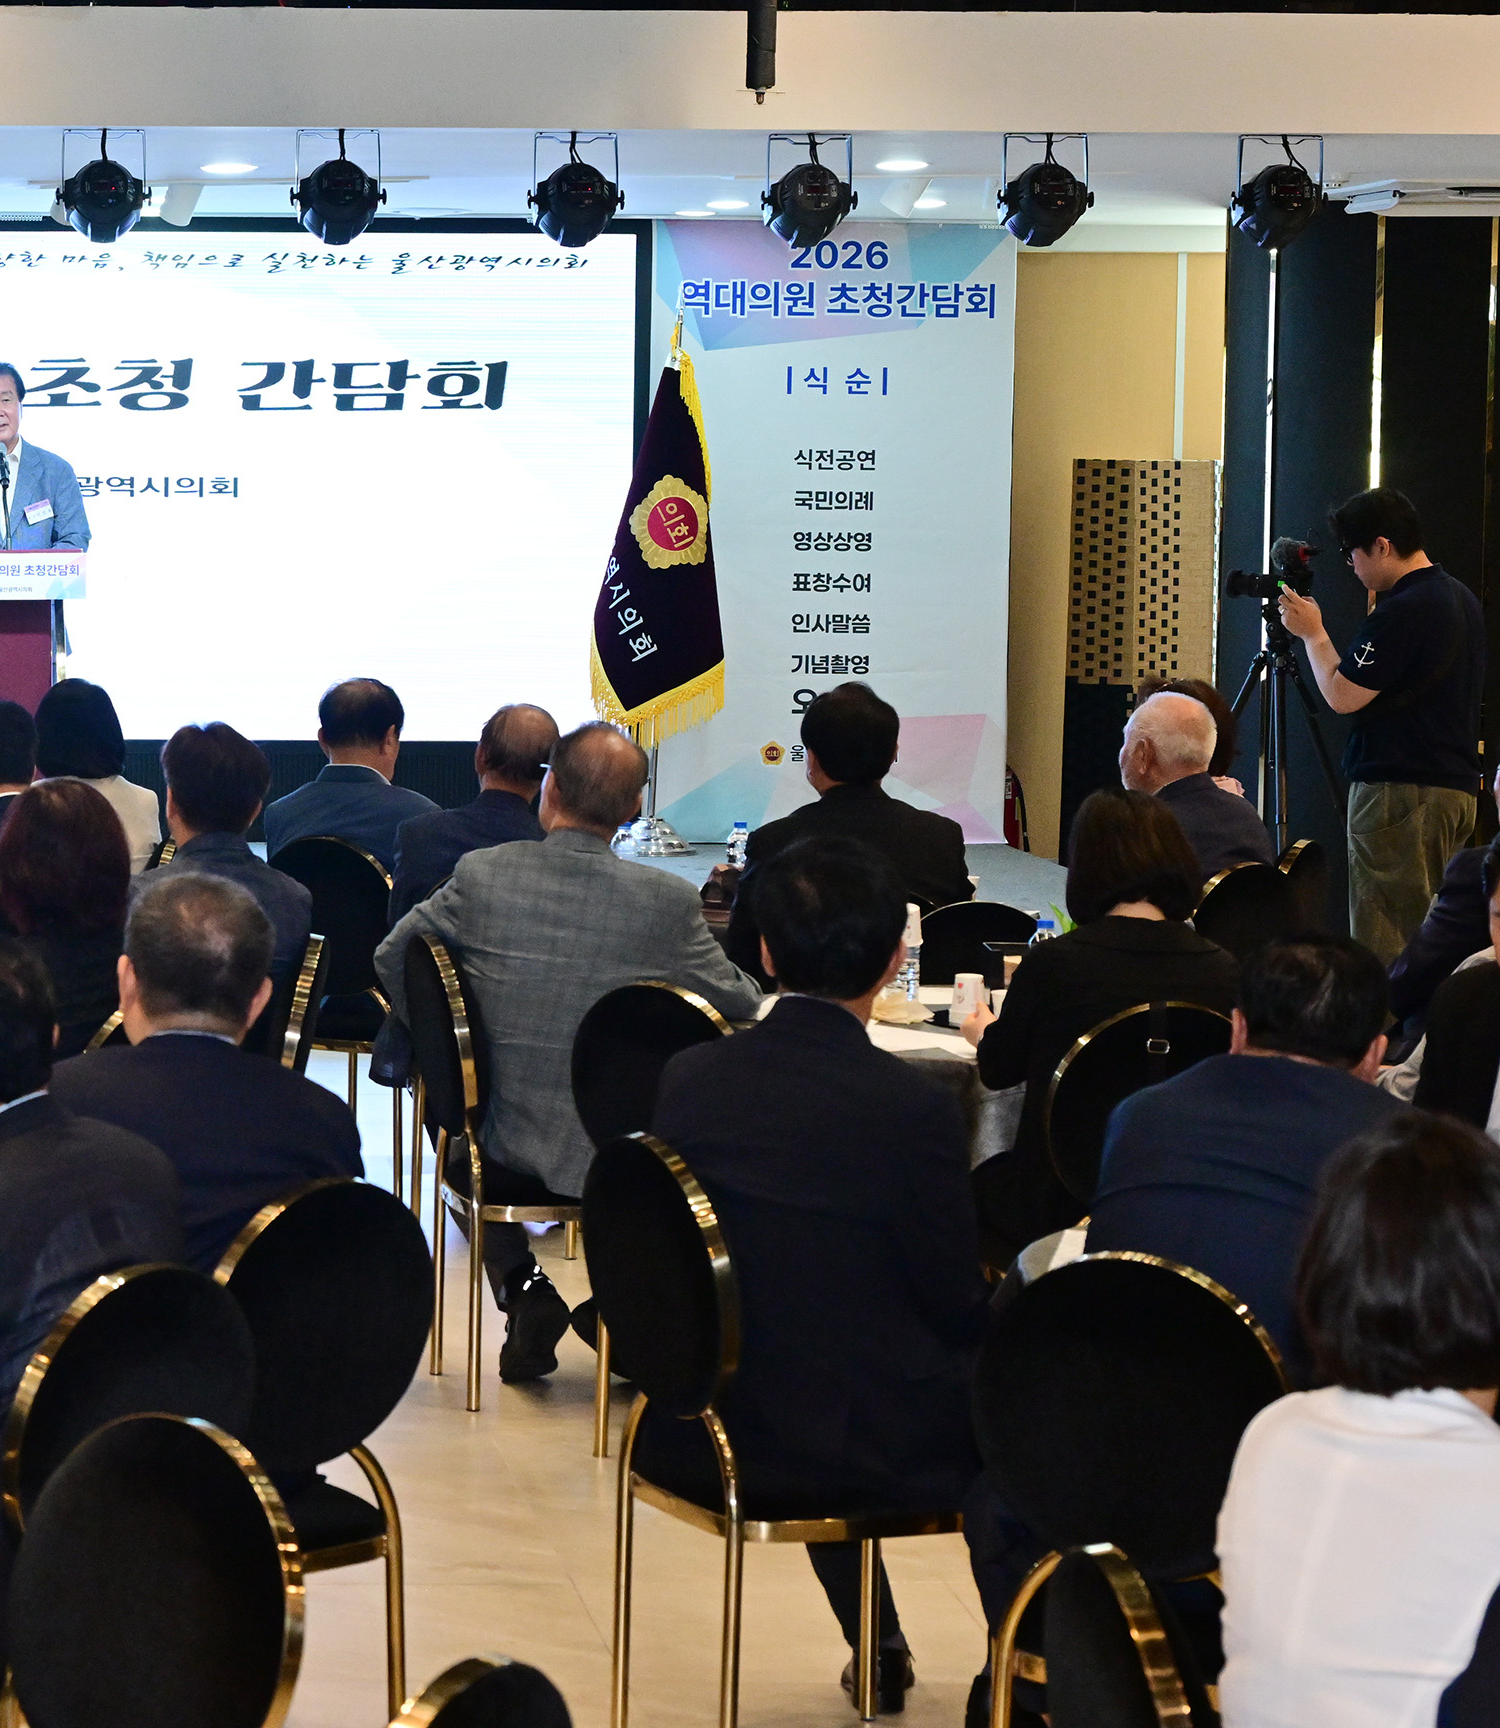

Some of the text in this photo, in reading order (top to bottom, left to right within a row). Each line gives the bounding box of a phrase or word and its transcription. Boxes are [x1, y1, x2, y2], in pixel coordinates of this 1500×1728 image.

[62, 252, 124, 272] 마음,
[140, 251, 245, 270] 책임으로
[261, 252, 375, 274] 실천하는
[391, 252, 589, 275] 울산광역시의회
[791, 240, 889, 270] 2026
[682, 279, 996, 319] 역대의원 초청간담회
[22, 357, 194, 412] 초청
[237, 359, 509, 413] 간담회
[794, 449, 877, 471] 식전공연
[77, 476, 239, 498] 광역시의회
[794, 490, 874, 511] 국민의례
[657, 502, 695, 549] 의회
[793, 532, 872, 552] 영상상영
[24, 564, 80, 577] 초청간담회
[792, 572, 871, 593] 표창수여
[604, 556, 658, 663] 역시의회
[791, 613, 871, 634] 인사말씀
[791, 654, 870, 675] 기념촬영
[791, 688, 818, 715] 오
